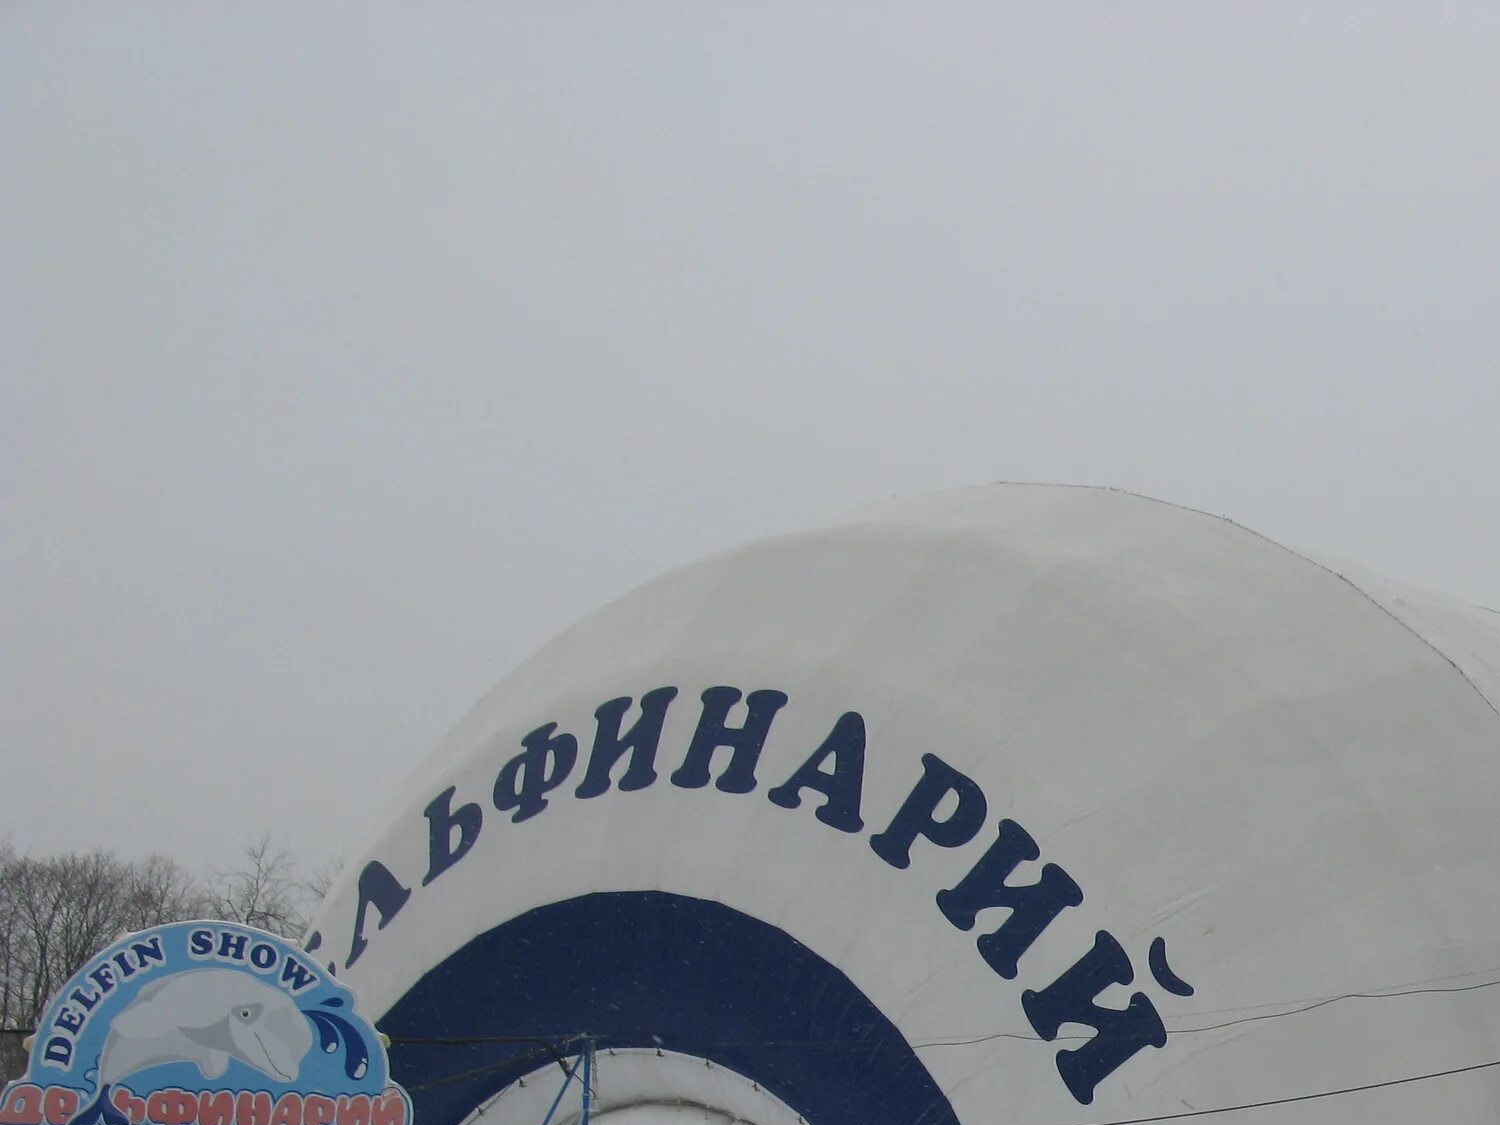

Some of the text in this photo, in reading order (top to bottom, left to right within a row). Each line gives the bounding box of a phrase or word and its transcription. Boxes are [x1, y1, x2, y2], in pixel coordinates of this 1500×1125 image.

[44, 929, 318, 1067] DELFIN SHOW
[303, 685, 1195, 1105] ЛЬФИНАРИЙ
